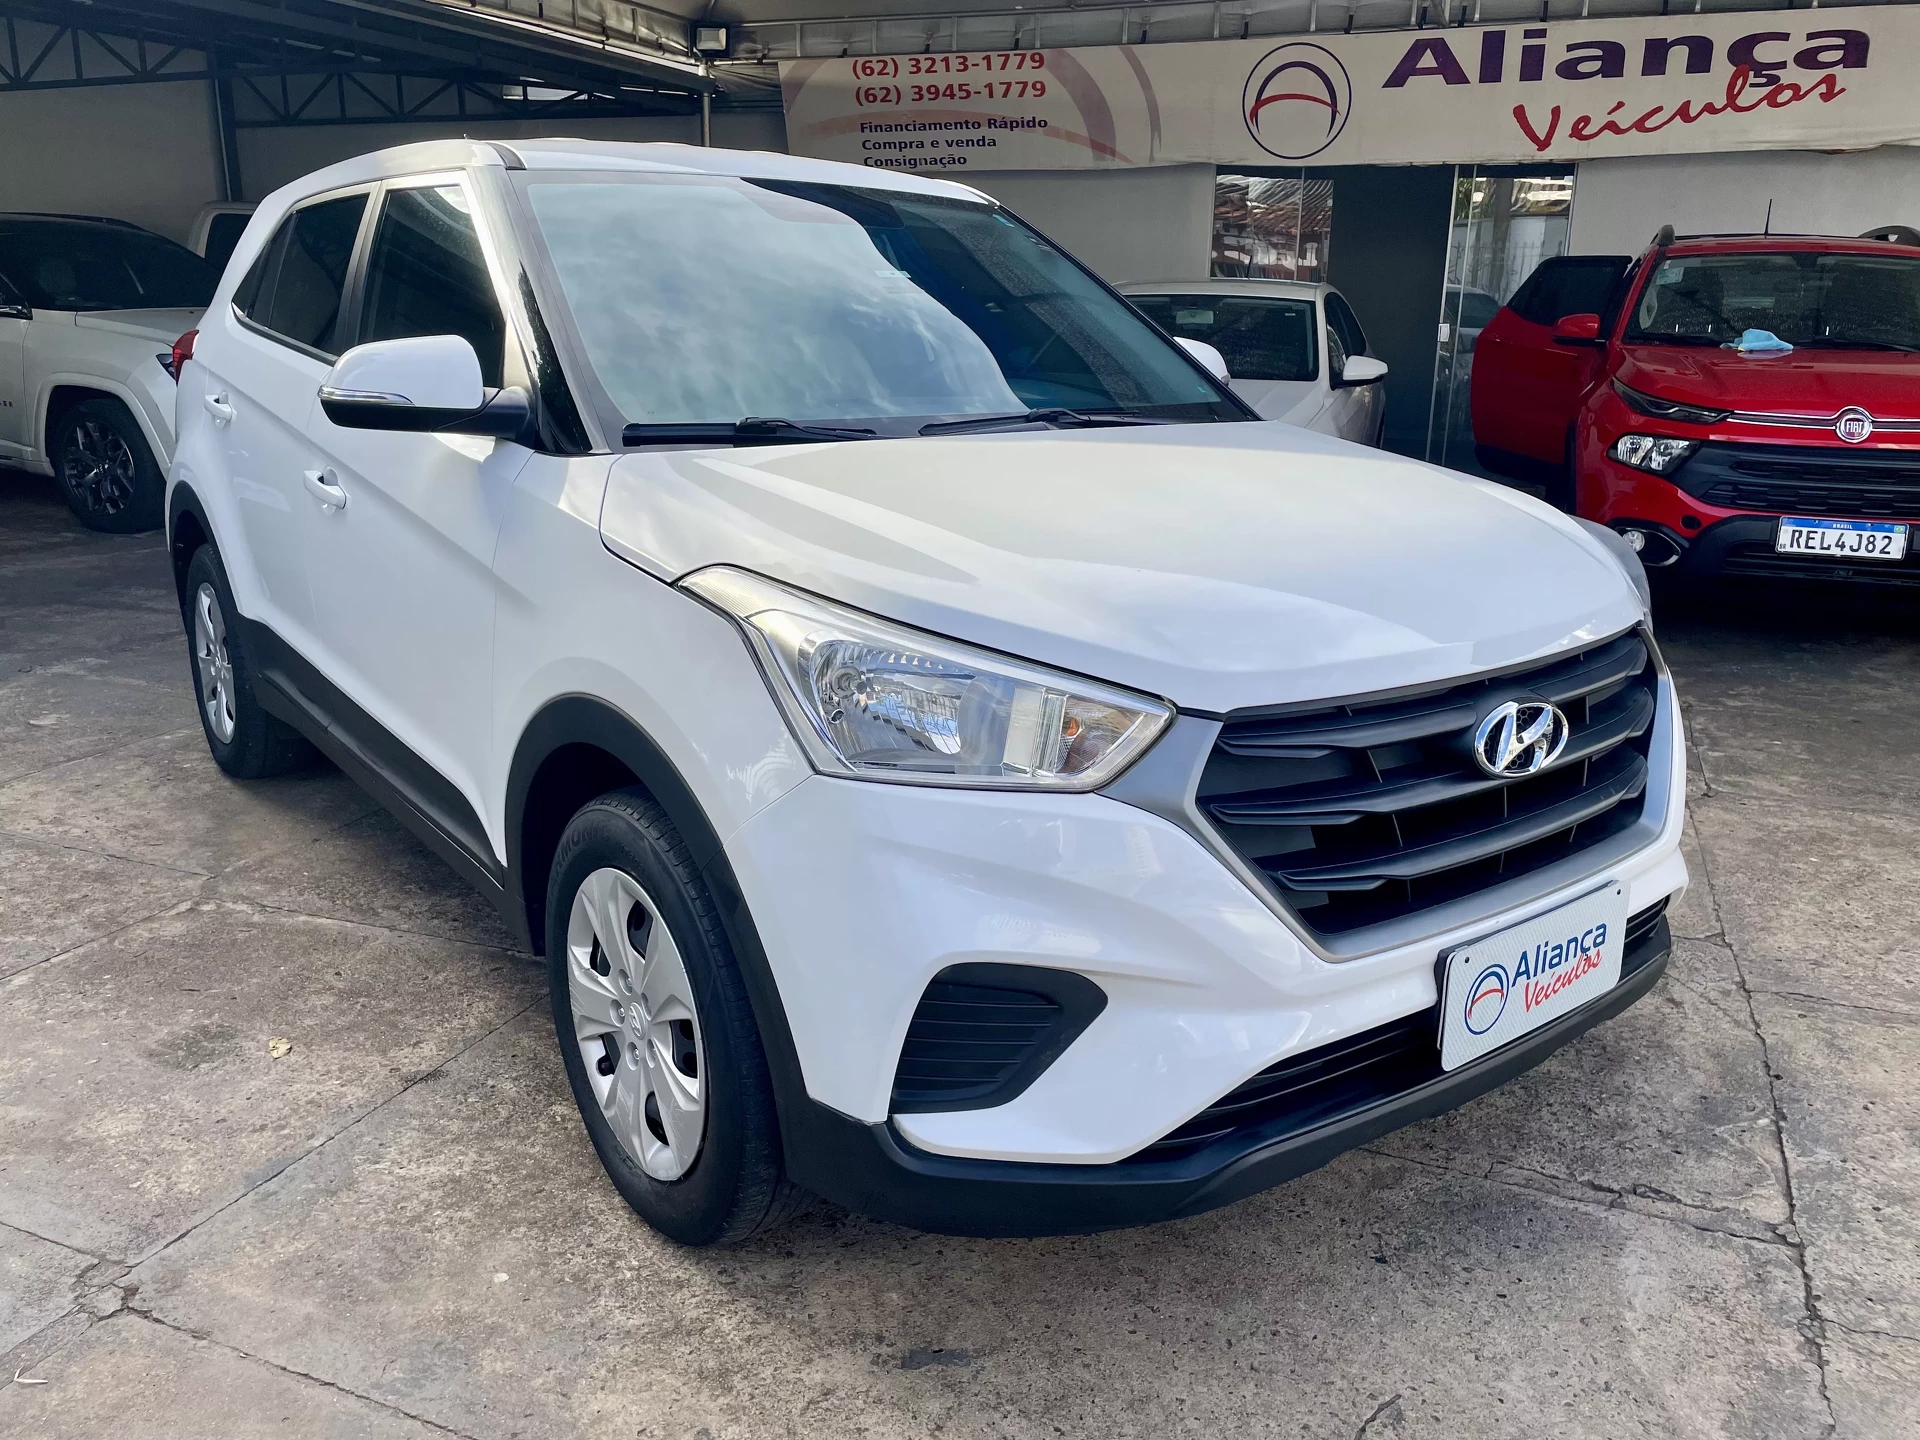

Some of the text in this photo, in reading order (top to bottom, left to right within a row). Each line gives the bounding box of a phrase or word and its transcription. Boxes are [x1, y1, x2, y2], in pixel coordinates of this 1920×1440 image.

[852, 52, 1045, 80] (62) 3213-1779
[1381, 28, 1870, 89] Aliança
[855, 80, 1047, 107] (62) 3945-1779
[1512, 64, 1847, 152] Veículos
[860, 116, 1049, 134] Financiamento Rápido
[861, 135, 997, 153] Compra e venda
[863, 153, 968, 169] Consignação
[1846, 421, 1864, 433] FIAT
[1789, 529, 1893, 555] REL4J82
[1511, 923, 1607, 988] Aliança
[1523, 949, 1603, 1013] Veículos
